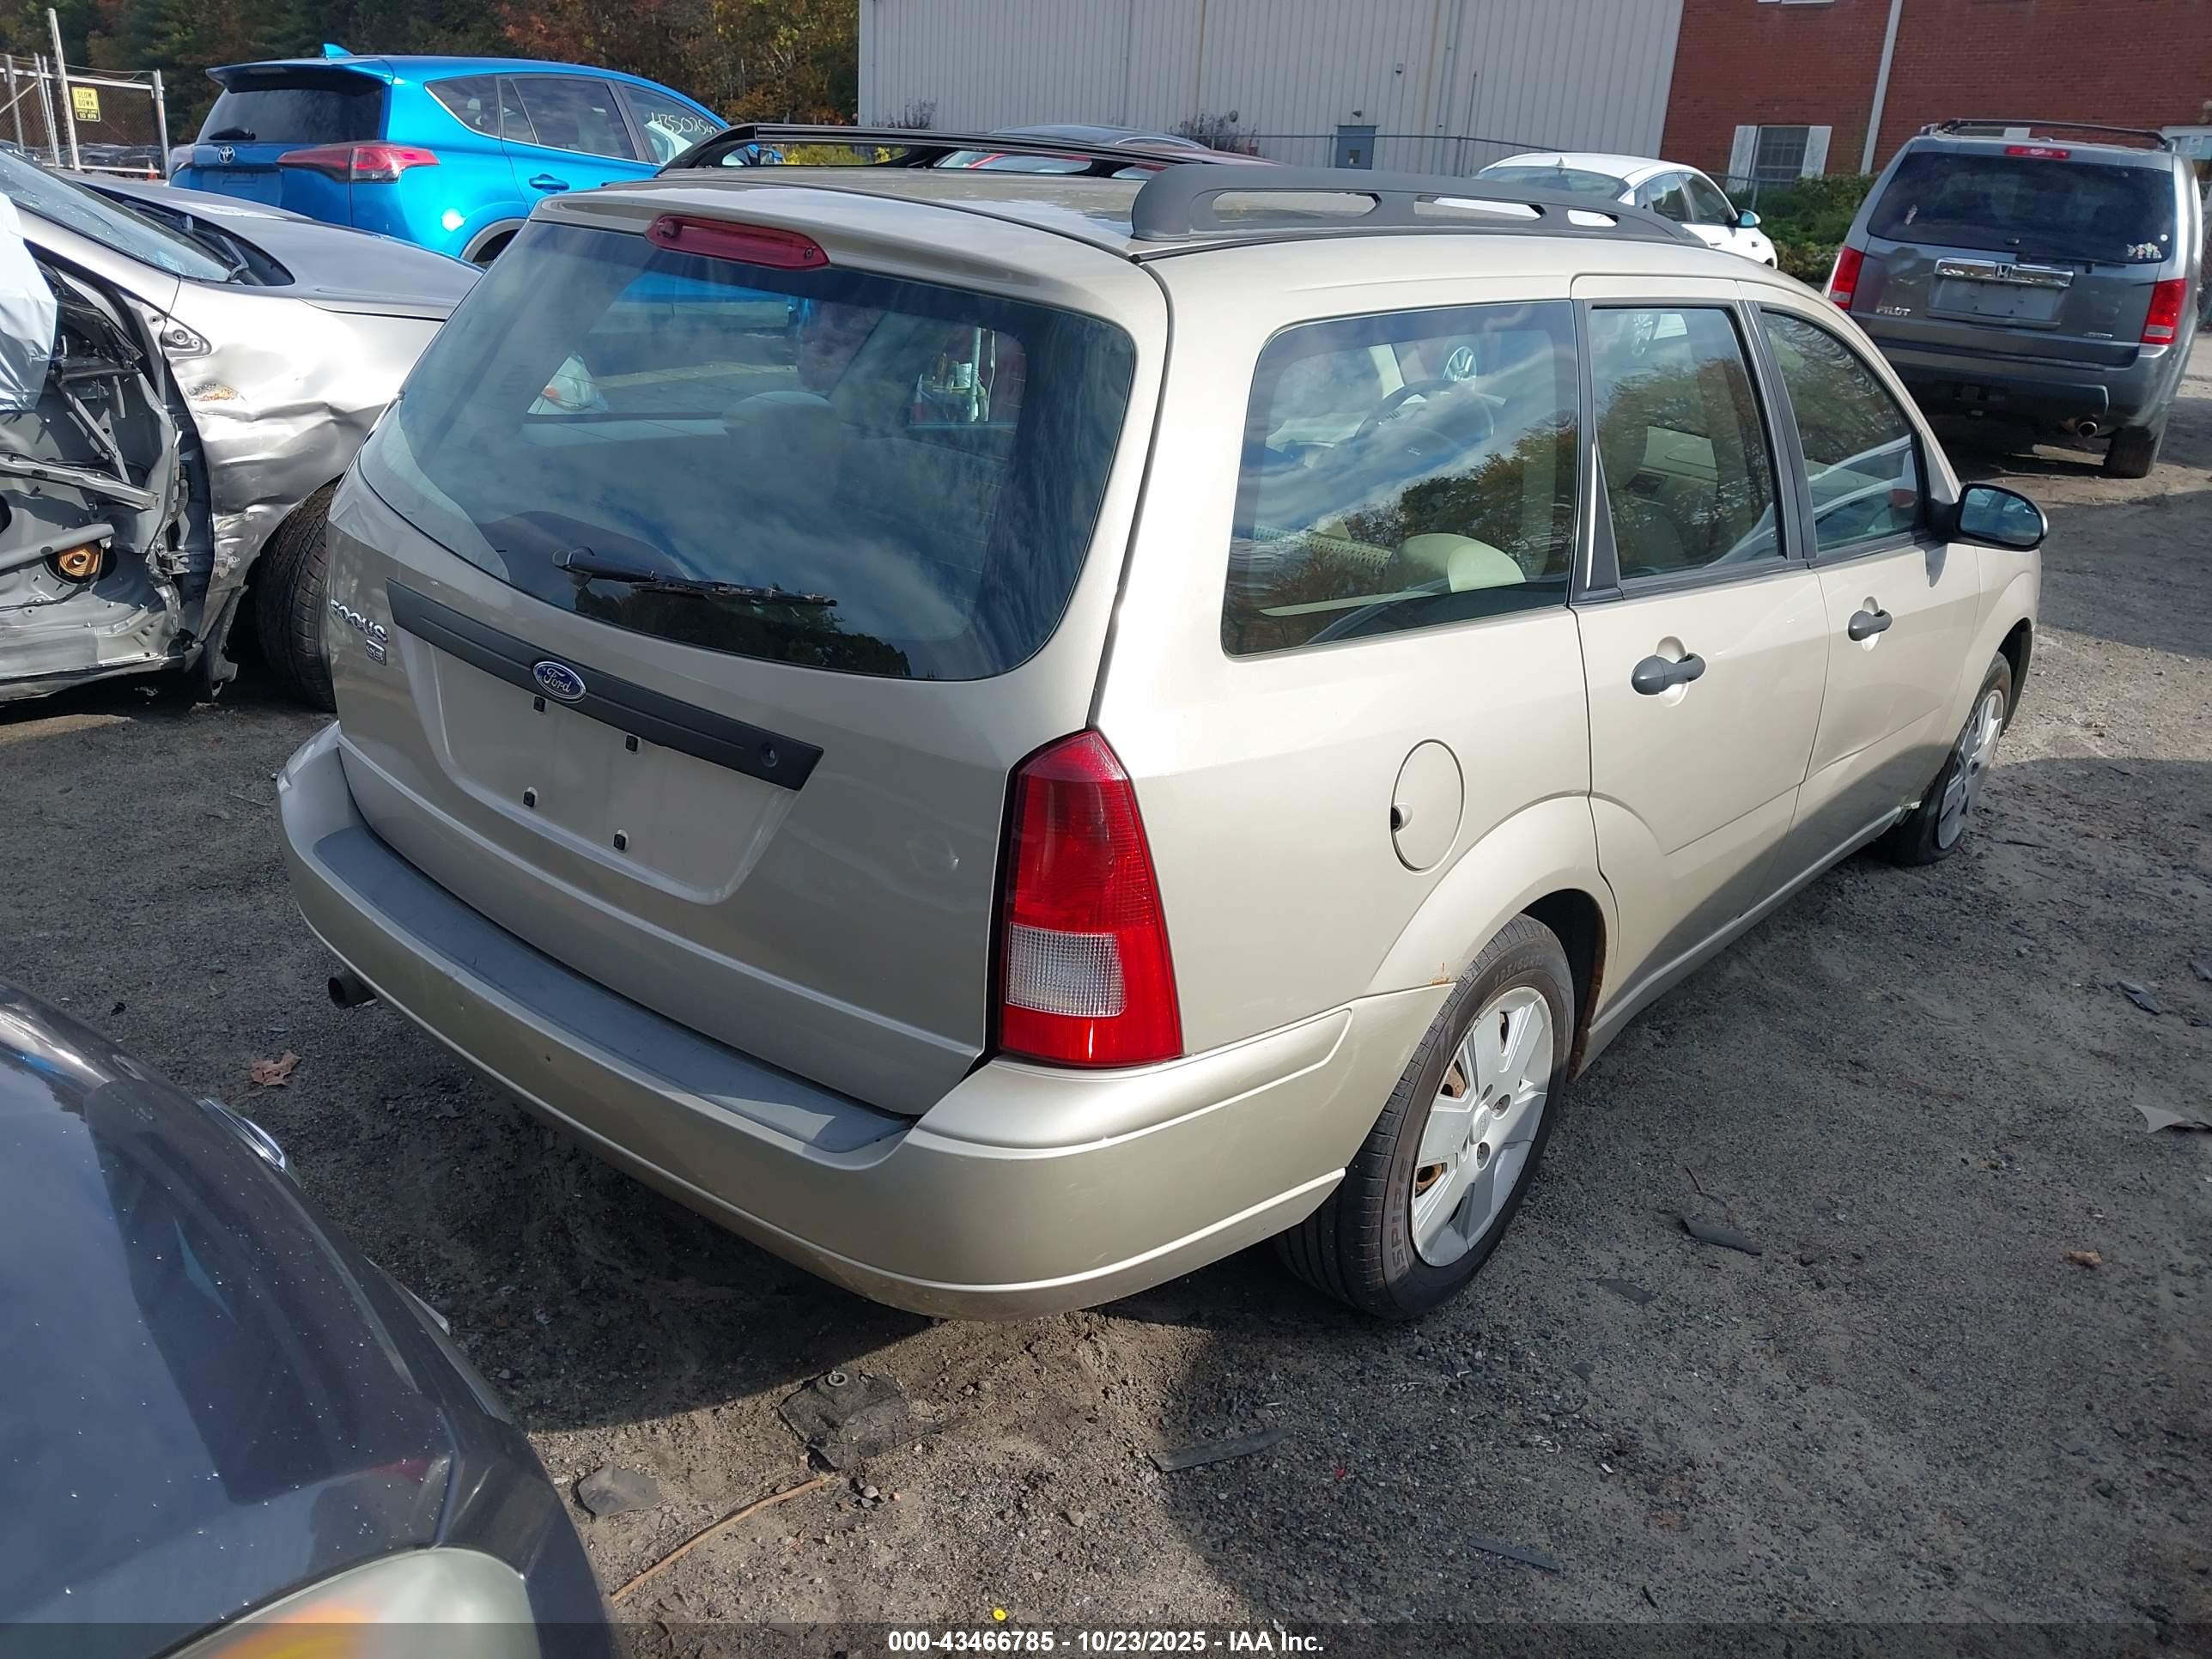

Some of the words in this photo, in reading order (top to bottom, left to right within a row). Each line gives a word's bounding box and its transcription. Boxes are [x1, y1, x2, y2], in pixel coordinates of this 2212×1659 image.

[77, 90, 92, 99] SLOW
[78, 99, 94, 107] DOWN
[1875, 306, 1911, 317] PILOT
[543, 667, 571, 693] Ford
